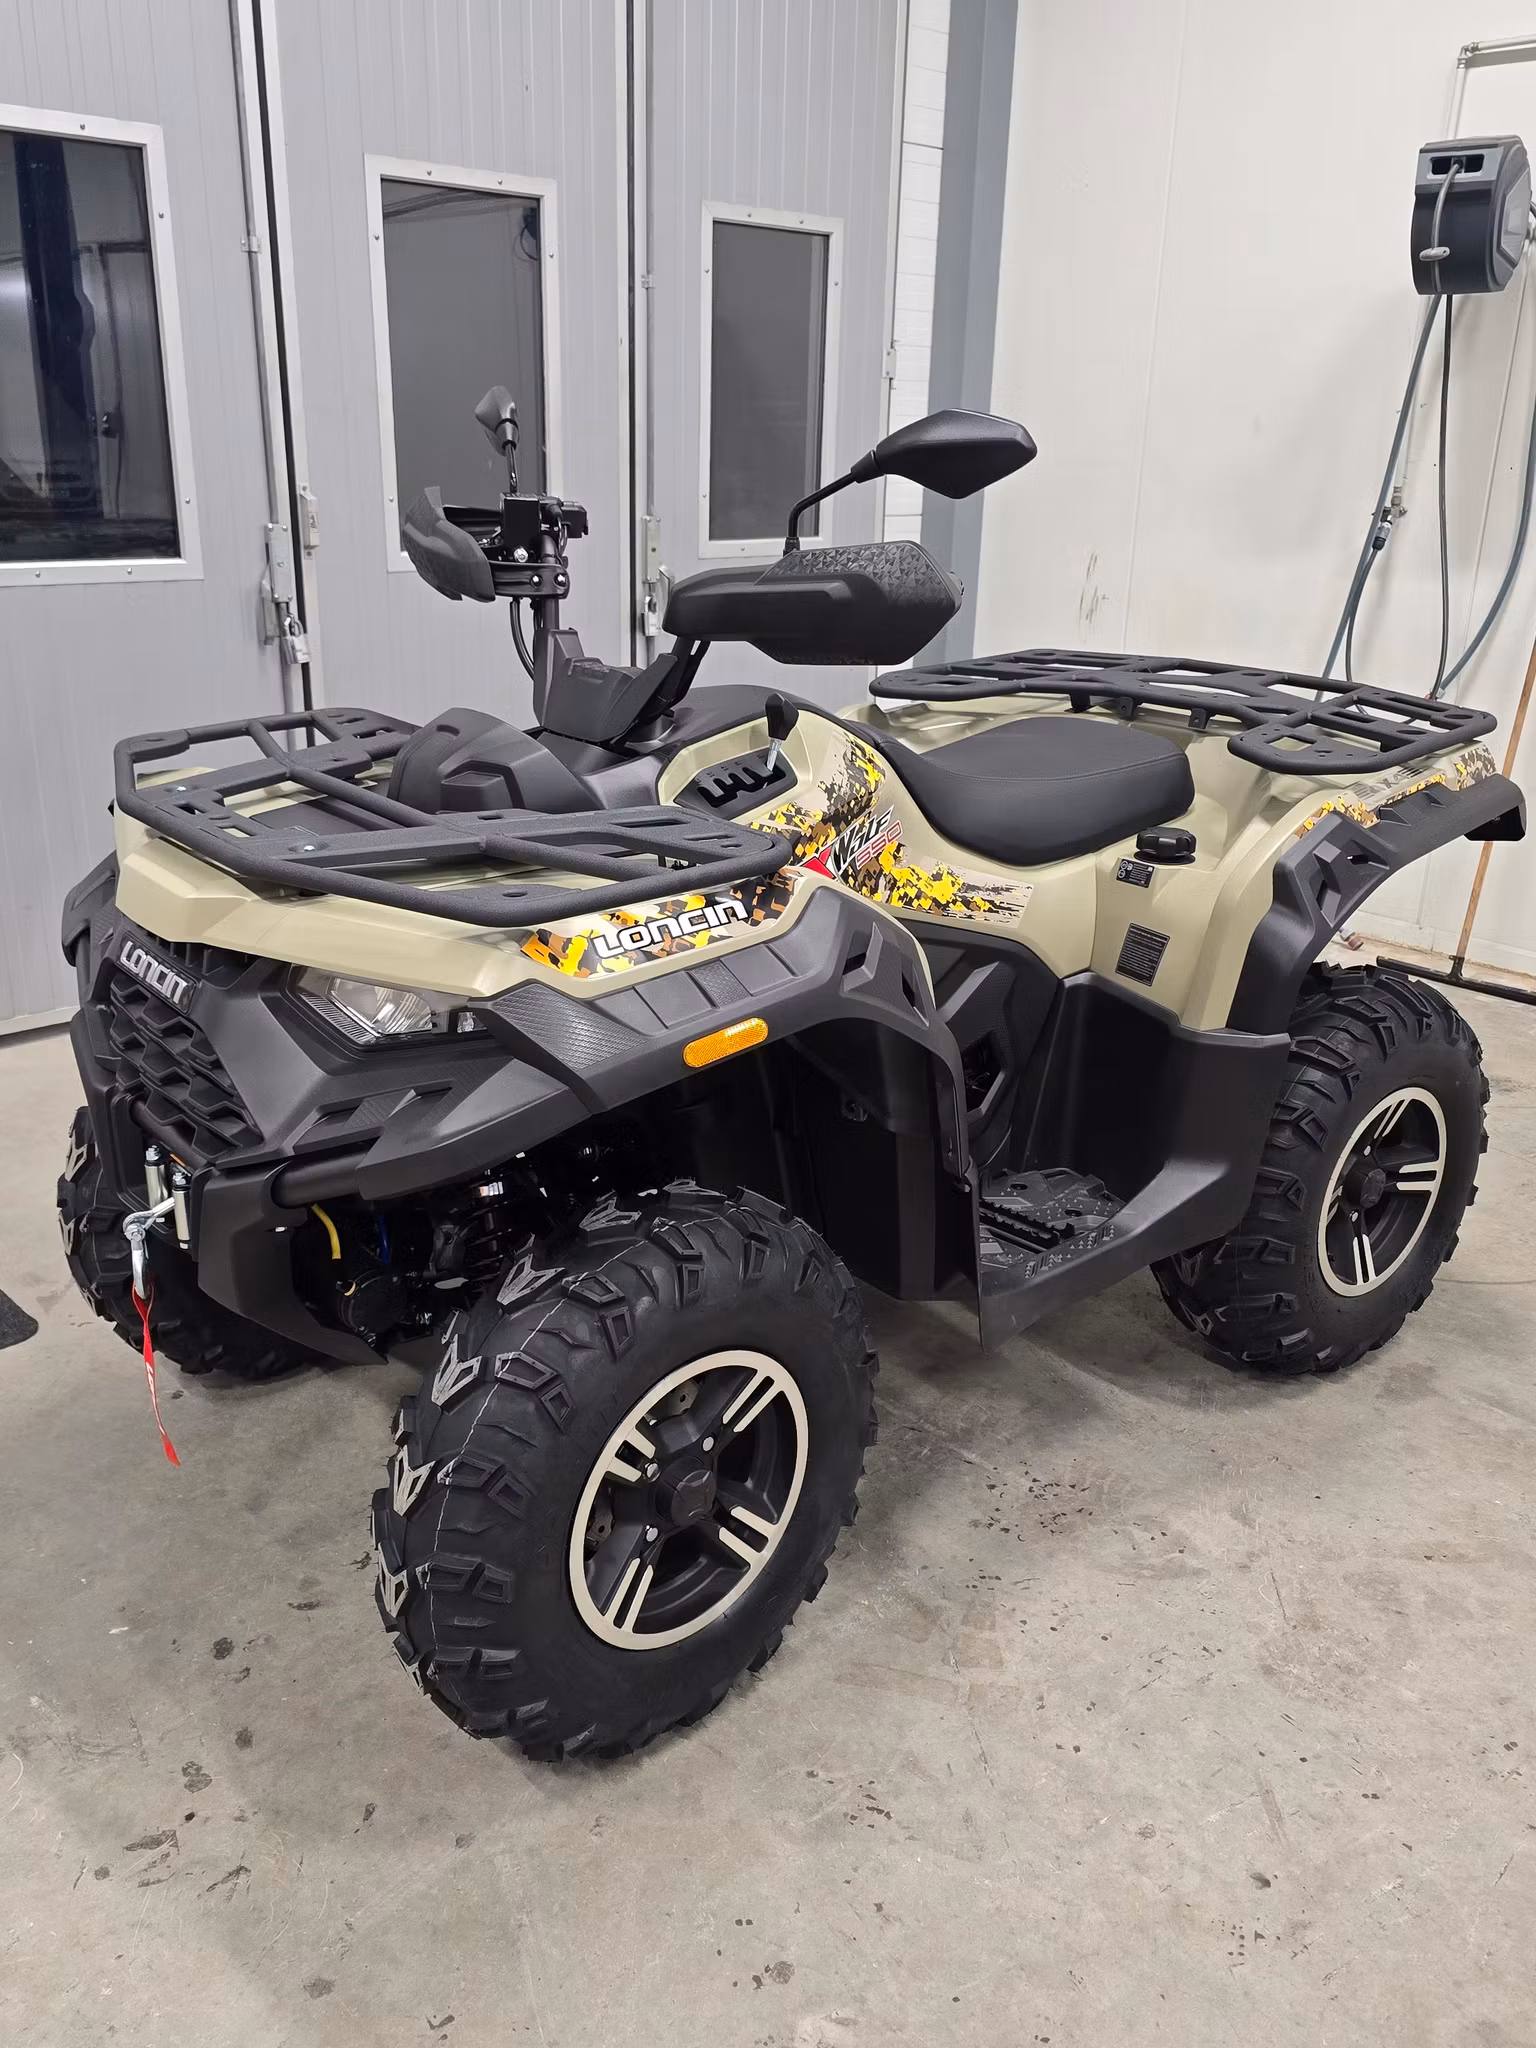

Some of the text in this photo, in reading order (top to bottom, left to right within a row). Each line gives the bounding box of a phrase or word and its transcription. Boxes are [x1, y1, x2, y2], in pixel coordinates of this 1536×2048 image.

[855, 820, 903, 869] 550
[590, 899, 749, 958] LONCIN
[120, 940, 188, 1004] LONCIN
